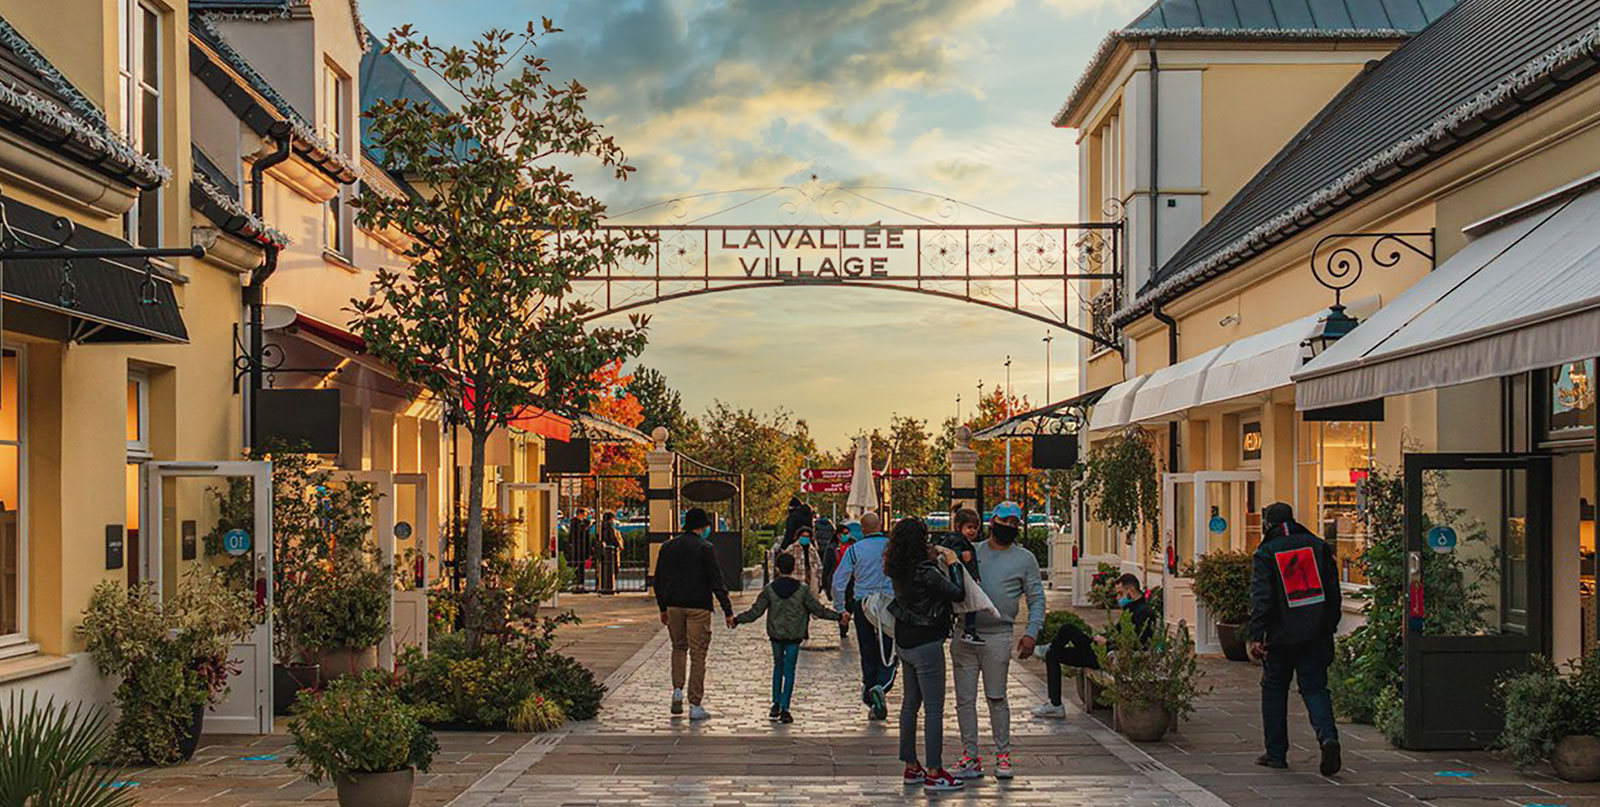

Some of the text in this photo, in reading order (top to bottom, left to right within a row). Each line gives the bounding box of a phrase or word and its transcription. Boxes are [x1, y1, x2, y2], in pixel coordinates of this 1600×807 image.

[722, 220, 904, 249] LA VALLÉE
[738, 257, 888, 278] VILLAGE
